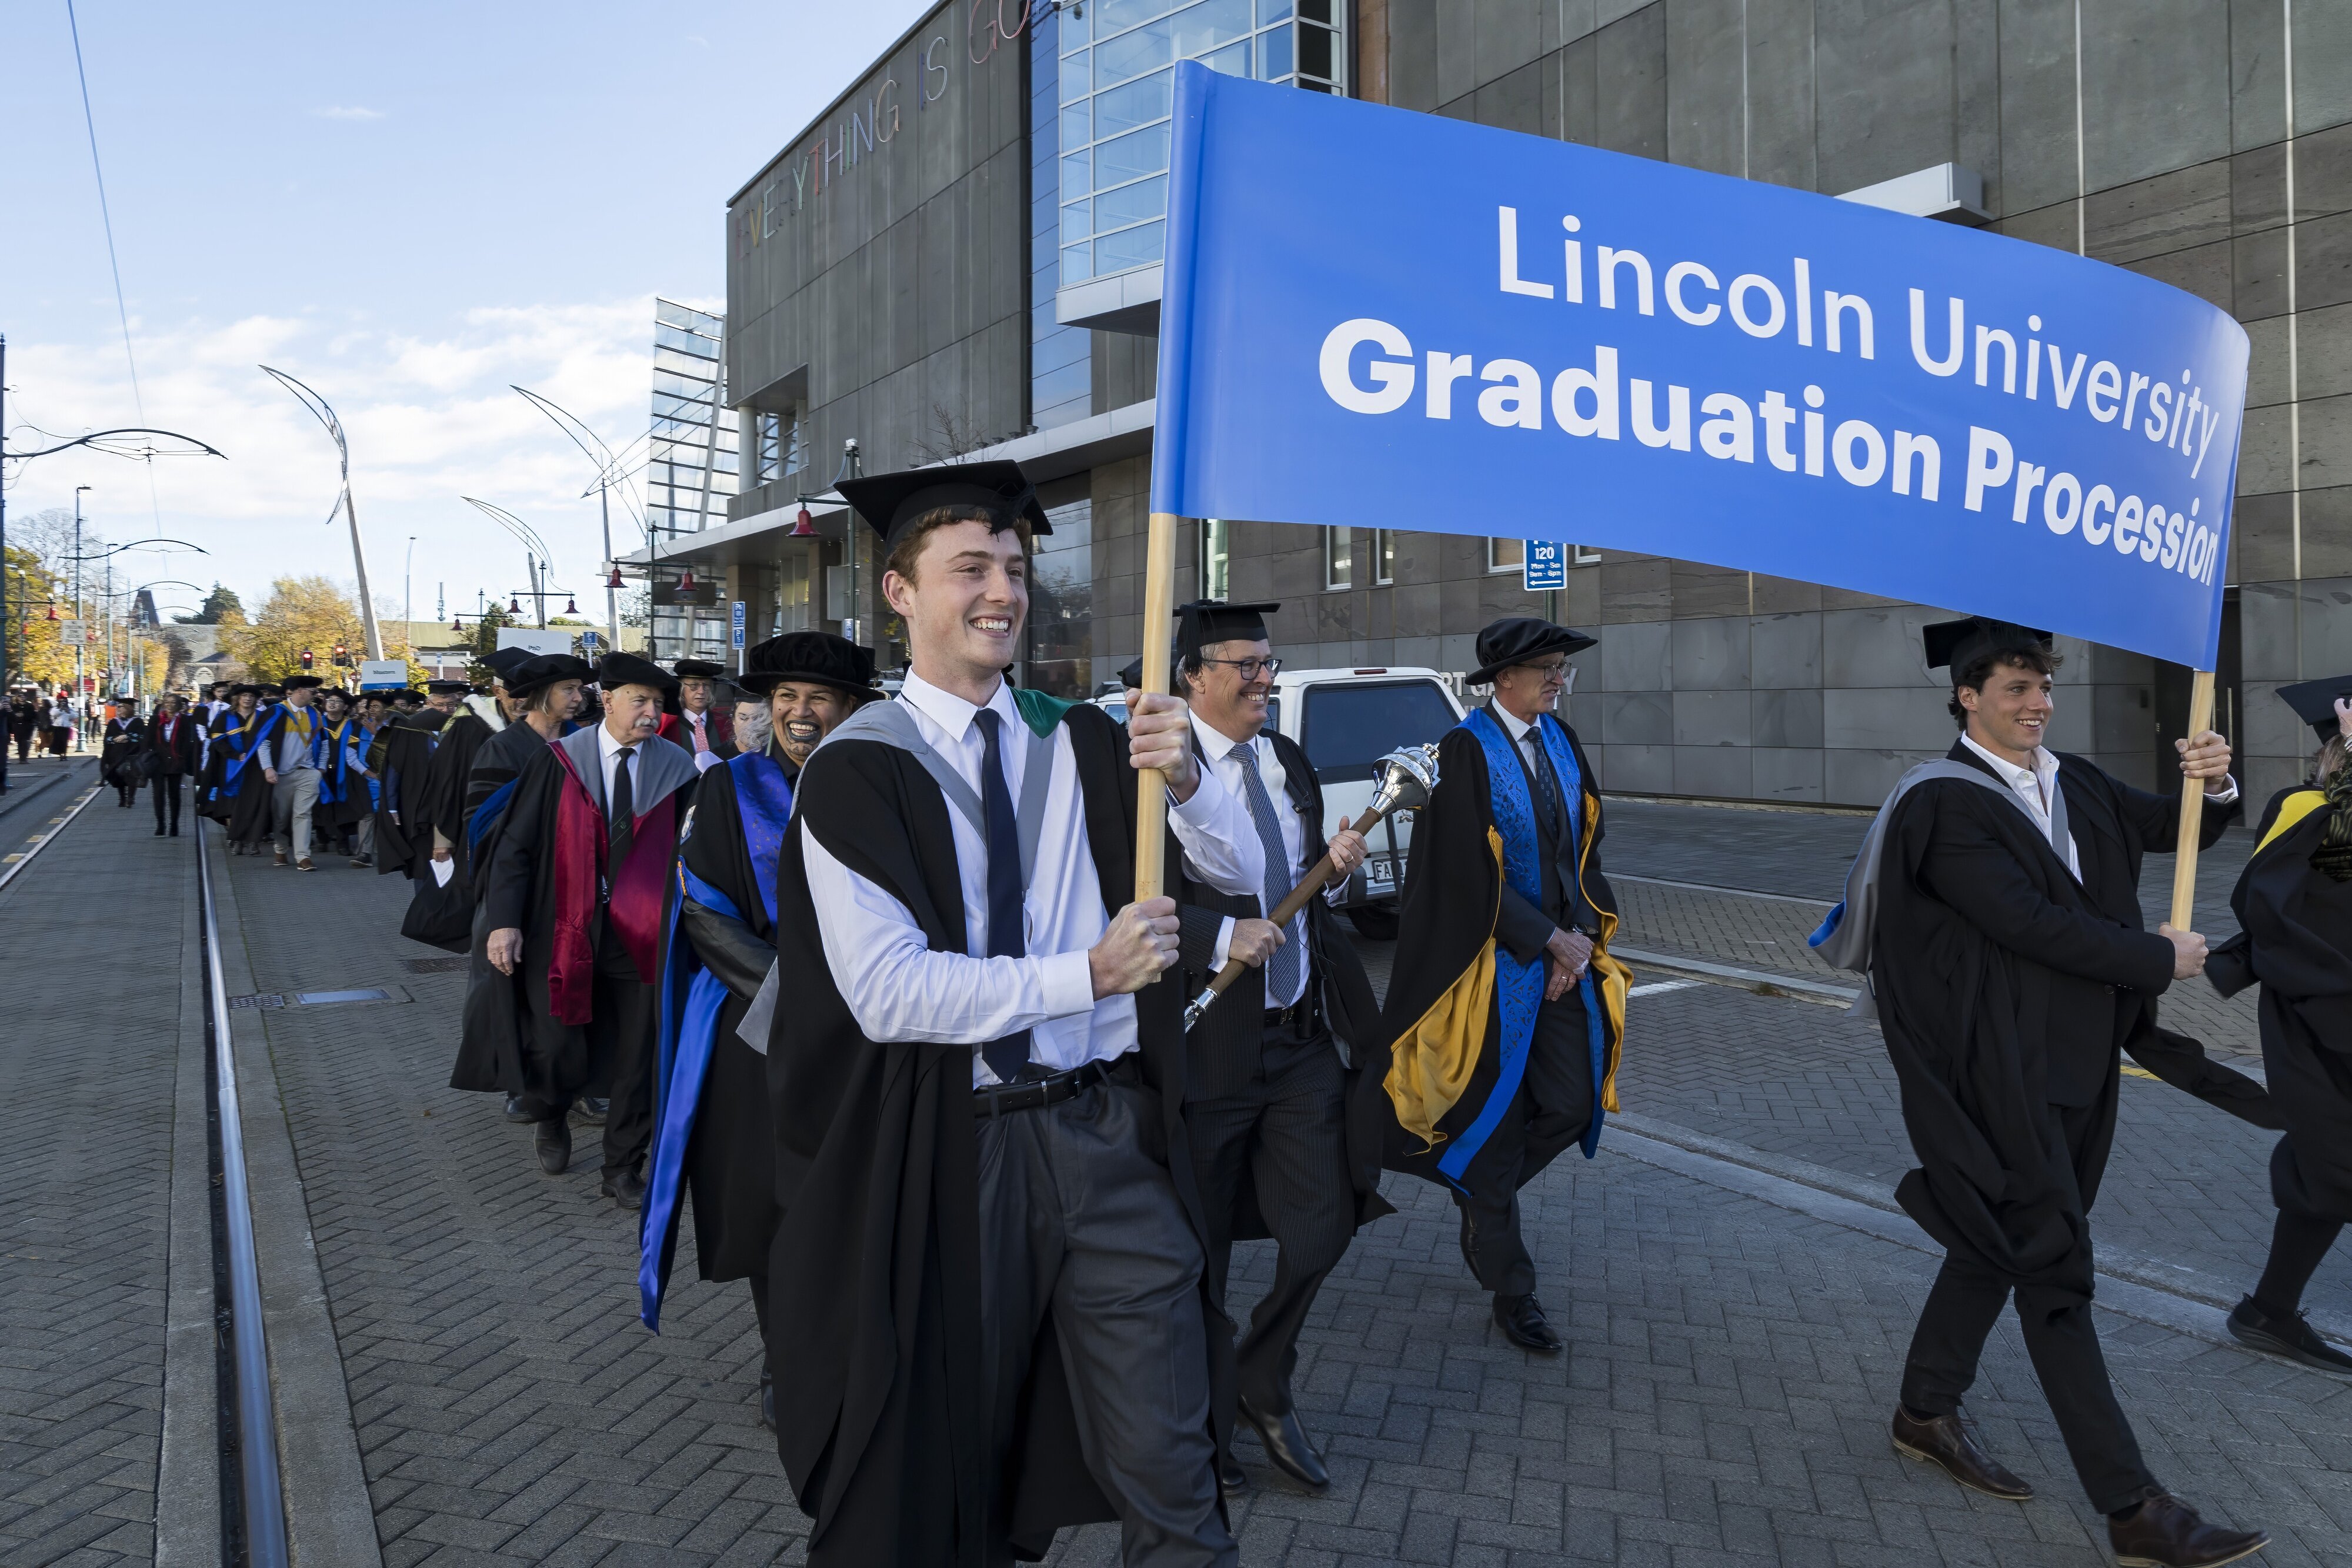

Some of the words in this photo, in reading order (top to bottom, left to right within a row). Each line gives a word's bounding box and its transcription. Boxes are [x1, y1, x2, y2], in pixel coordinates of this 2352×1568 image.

[920, 36, 948, 111] IS
[1498, 205, 1874, 361] Lincoln
[1909, 287, 2221, 480] University
[1319, 318, 1941, 502] Graduation
[1964, 425, 2218, 586] Procession
[1534, 546, 1555, 560] 120
